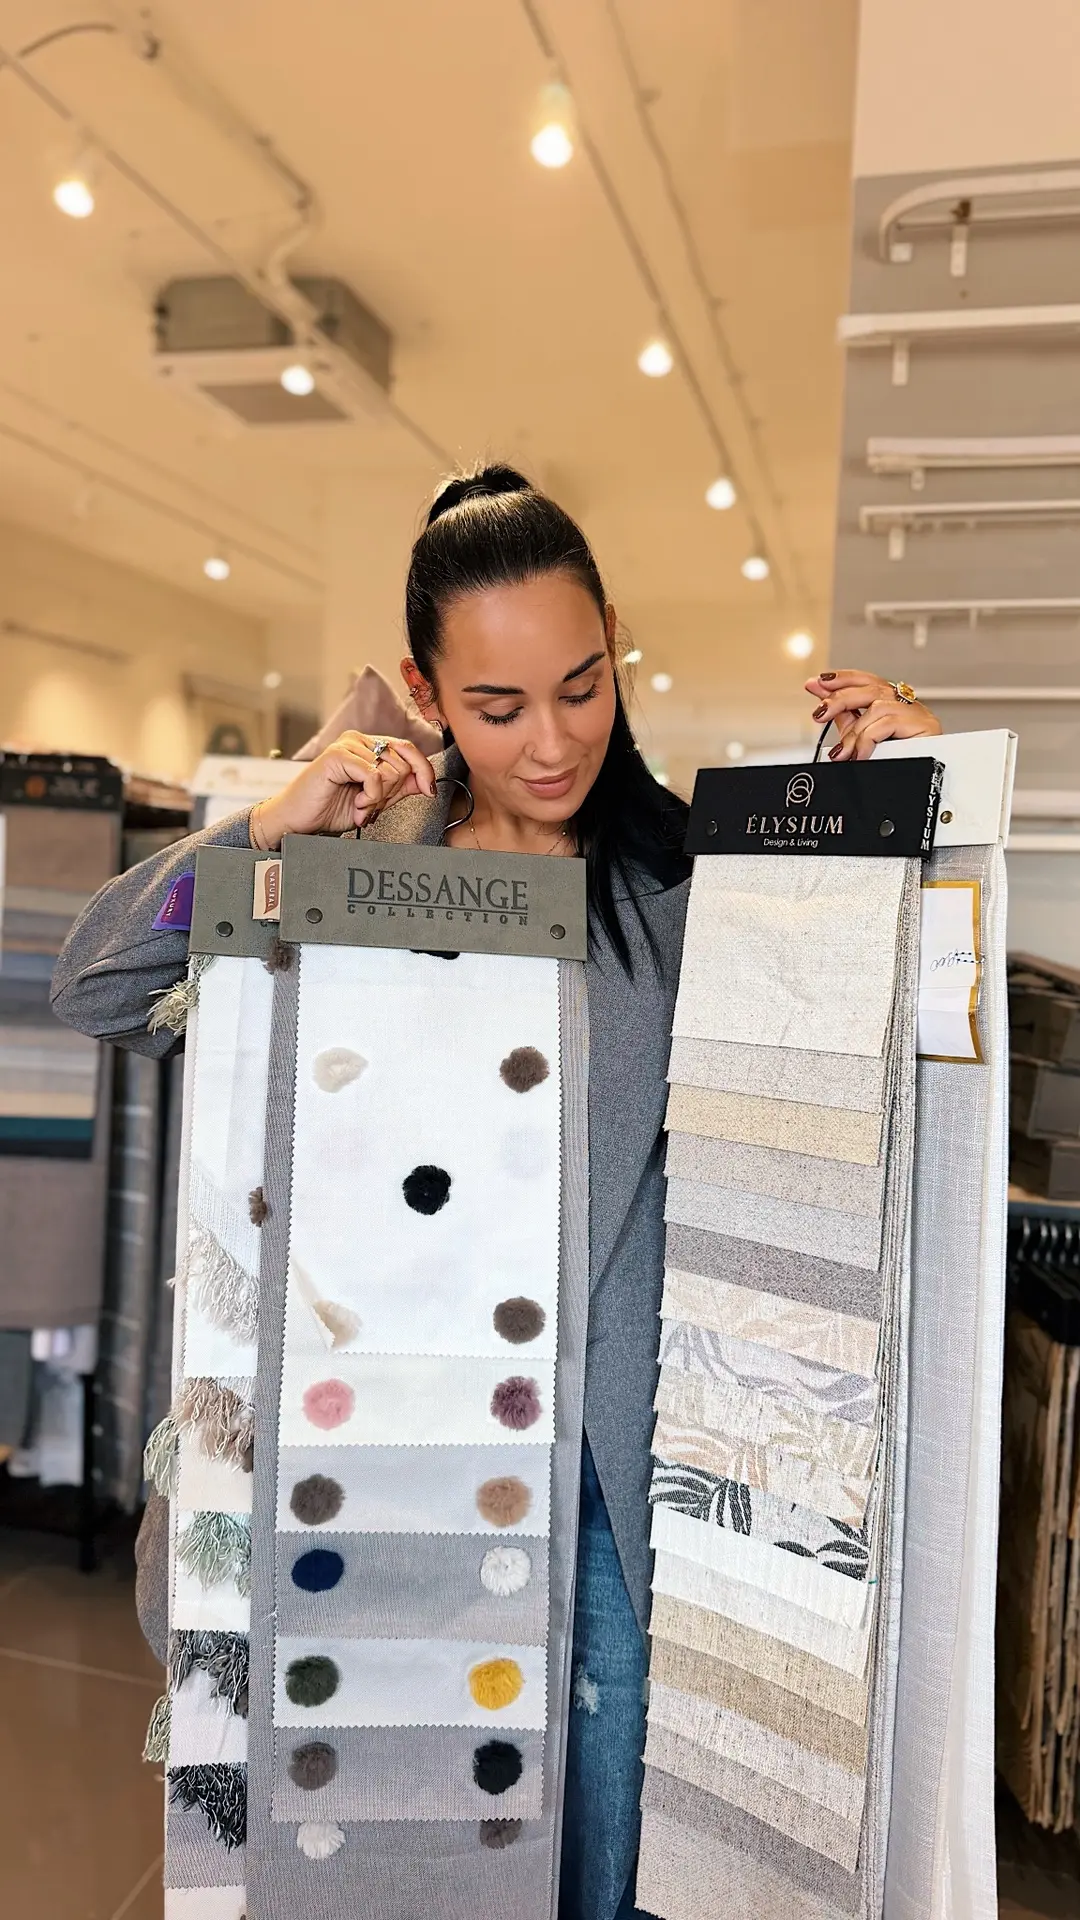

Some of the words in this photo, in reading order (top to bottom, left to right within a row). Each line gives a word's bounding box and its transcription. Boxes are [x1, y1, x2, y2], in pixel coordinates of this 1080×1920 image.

[745, 813, 844, 834] ÉLYSIUM
[763, 838, 789, 848] Design
[789, 838, 796, 846] &
[797, 838, 819, 848] Living
[268, 871, 276, 908] NATURAL
[347, 867, 529, 911] DESSANGE
[166, 888, 178, 917] LUXURY
[347, 904, 528, 926] COLLECTION
